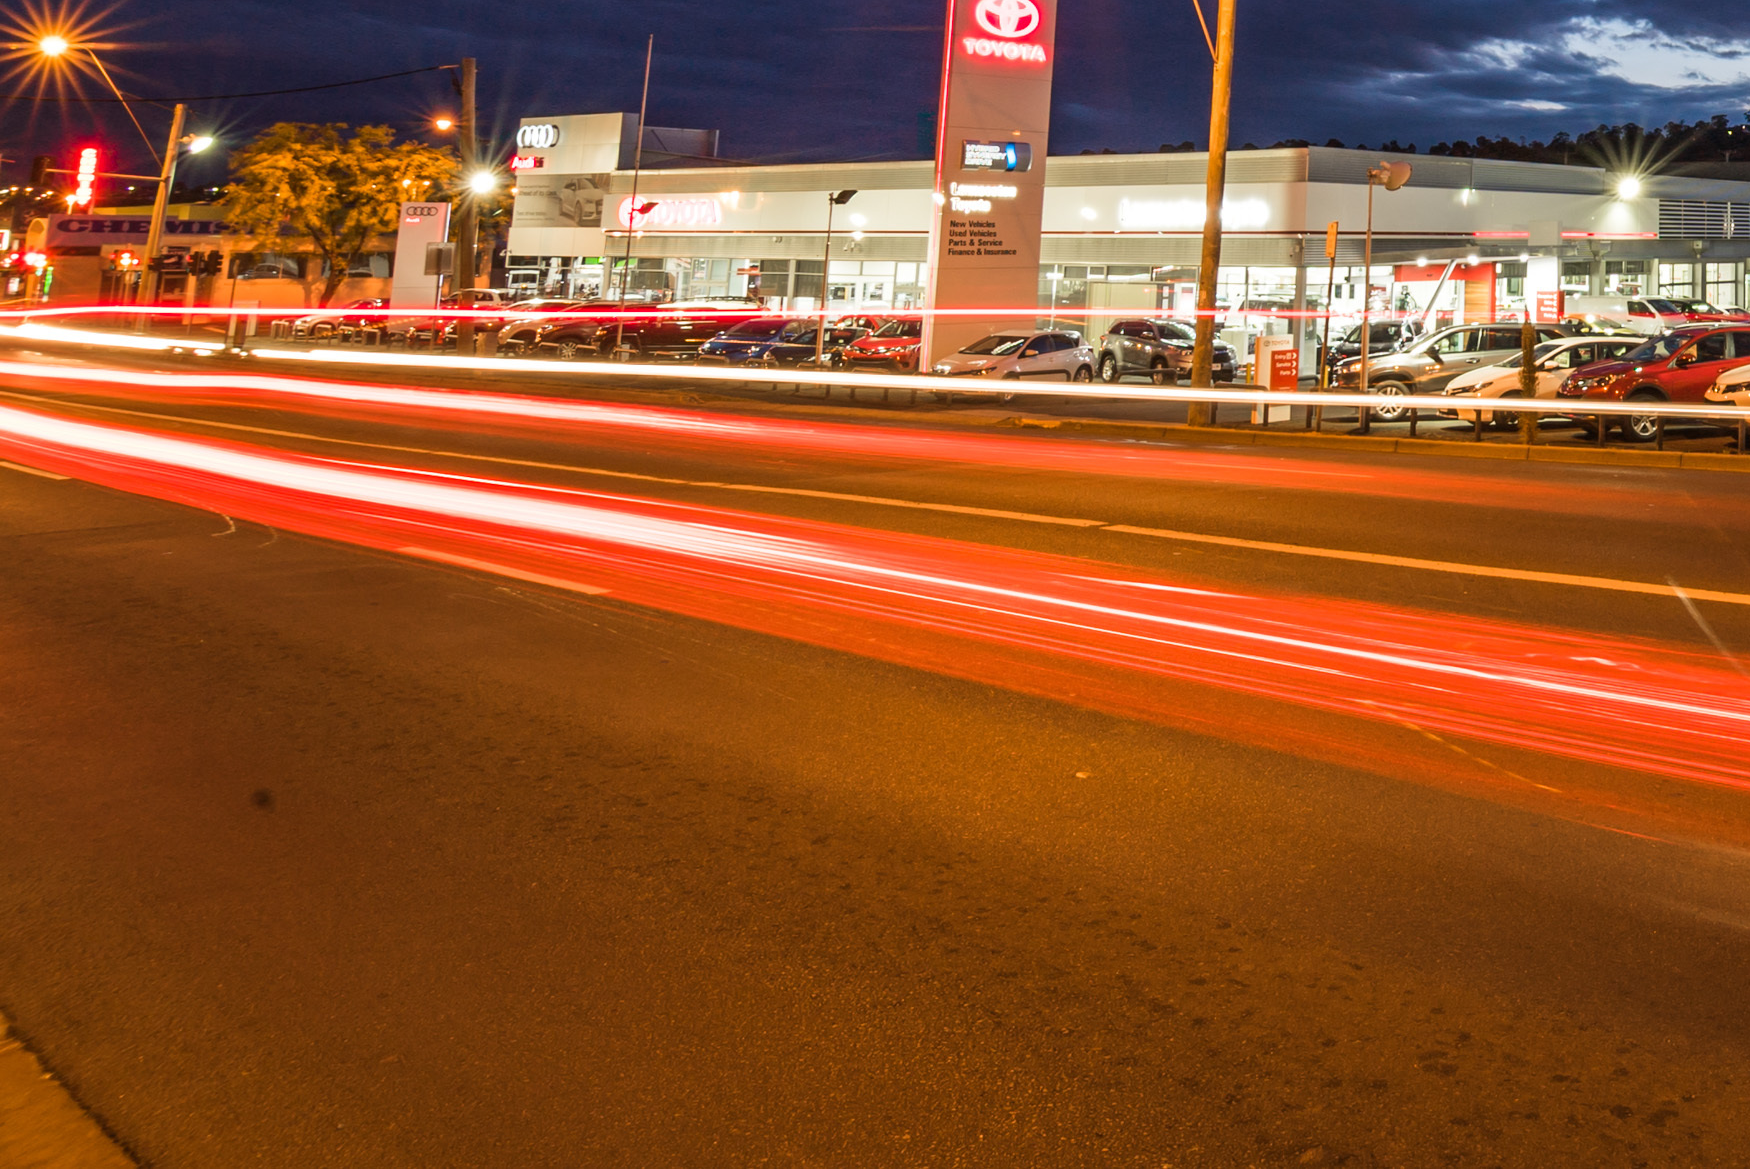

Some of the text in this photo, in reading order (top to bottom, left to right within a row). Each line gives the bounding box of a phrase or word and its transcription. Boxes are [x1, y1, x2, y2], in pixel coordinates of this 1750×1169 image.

[963, 37, 1047, 62] TOYOTA
[511, 156, 536, 169] Audi
[57, 219, 256, 235] CHEMIS
[968, 220, 996, 228] Vehicles
